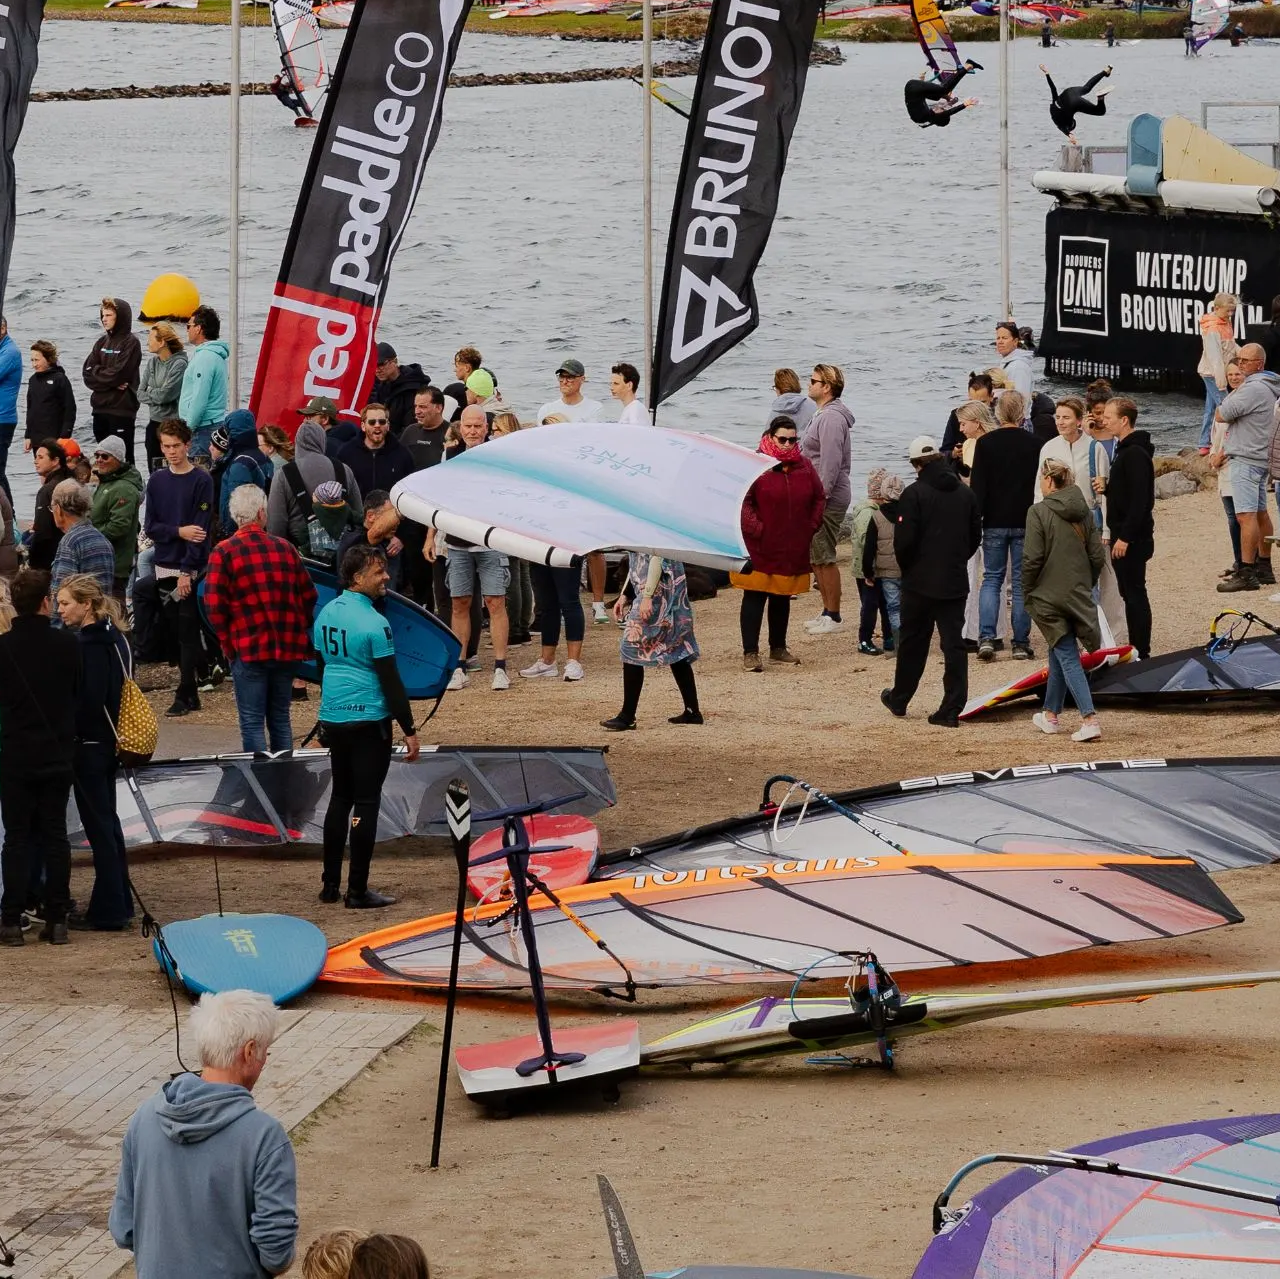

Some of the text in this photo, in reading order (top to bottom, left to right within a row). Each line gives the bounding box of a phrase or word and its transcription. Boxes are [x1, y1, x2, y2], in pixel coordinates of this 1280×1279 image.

[1065, 254, 1102, 270] BROUWERS
[1136, 251, 1248, 295] WATERJUMP
[1063, 268, 1102, 309] DAM
[271, 294, 357, 403] red
[321, 625, 349, 658] 151
[899, 758, 1168, 791] SEVERNE
